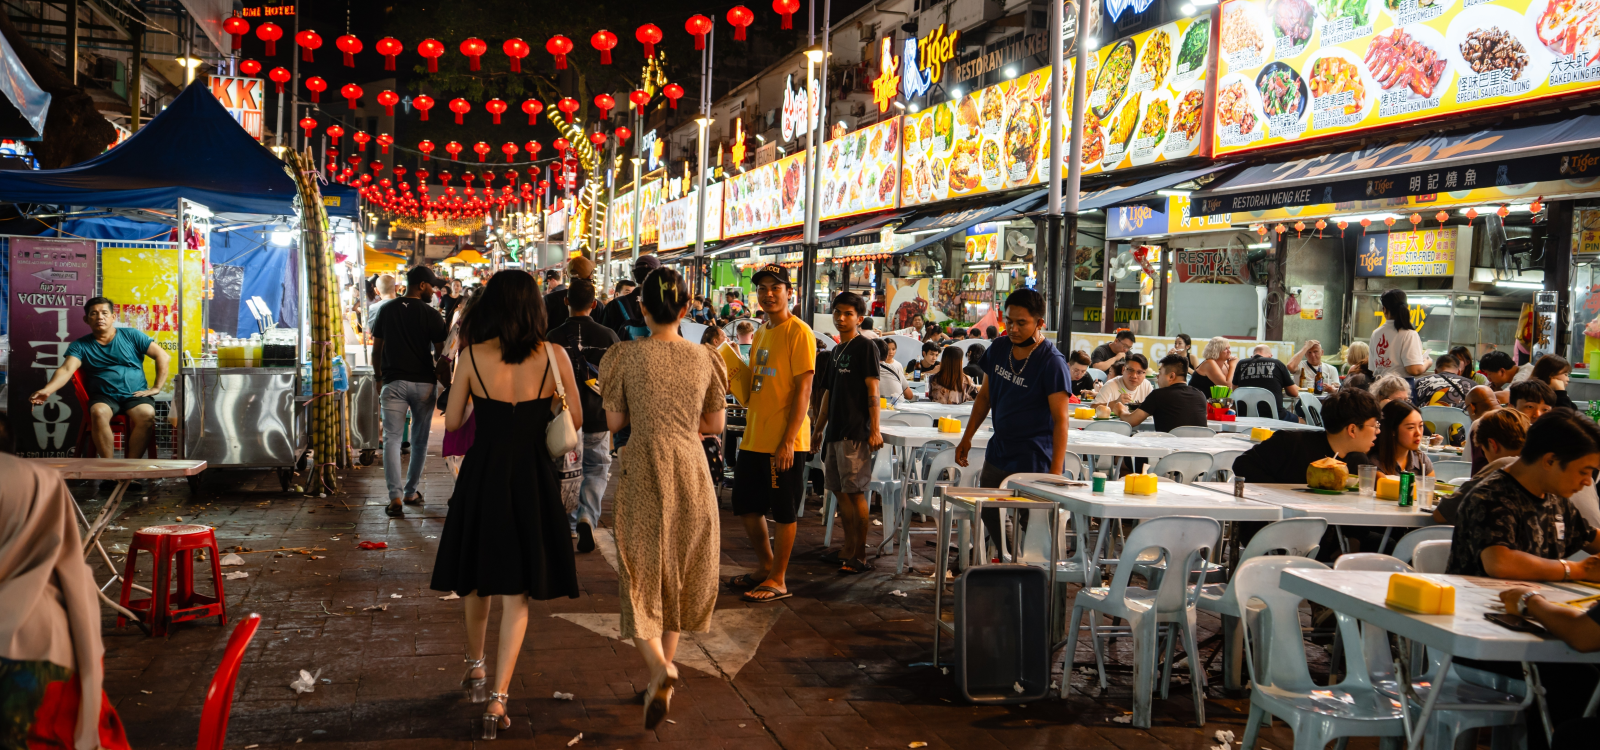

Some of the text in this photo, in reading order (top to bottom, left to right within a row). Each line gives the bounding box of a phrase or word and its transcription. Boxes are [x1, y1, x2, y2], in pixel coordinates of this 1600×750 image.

[264, 6, 296, 16] HOTEL
[1416, 6, 1442, 21] OMELETTE
[917, 23, 961, 84] Tiger
[955, 48, 1002, 84] RESTORAN
[1028, 30, 1049, 56] KEE
[1549, 52, 1589, 73] 大头虾
[1457, 67, 1512, 92] 怪味巴里冬
[1549, 73, 1571, 85] BAKED
[1572, 69, 1589, 81] KING
[213, 77, 258, 110] KK
[1456, 80, 1530, 102] SPECIAL SAUCE BALITONG
[1313, 110, 1328, 122] SWEET
[1399, 101, 1421, 114] CHICKEN
[1421, 98, 1440, 110] WINGS
[1571, 153, 1600, 173] Tiger
[1374, 179, 1395, 195] Tiger
[1409, 168, 1477, 193] 明記燒魚
[1207, 199, 1222, 211] Tiger
[1232, 188, 1311, 209] RESTORAN MENG KEE
[1128, 206, 1153, 228] Tiger
[1408, 231, 1435, 251] 大炒
[1360, 252, 1385, 272] Tiger
[1405, 251, 1436, 262] STIR-FRIED
[1188, 264, 1210, 276] LIM
[1393, 264, 1411, 275] PENANG
[1411, 264, 1424, 275] FRIED
[1433, 263, 1448, 275] TEOW
